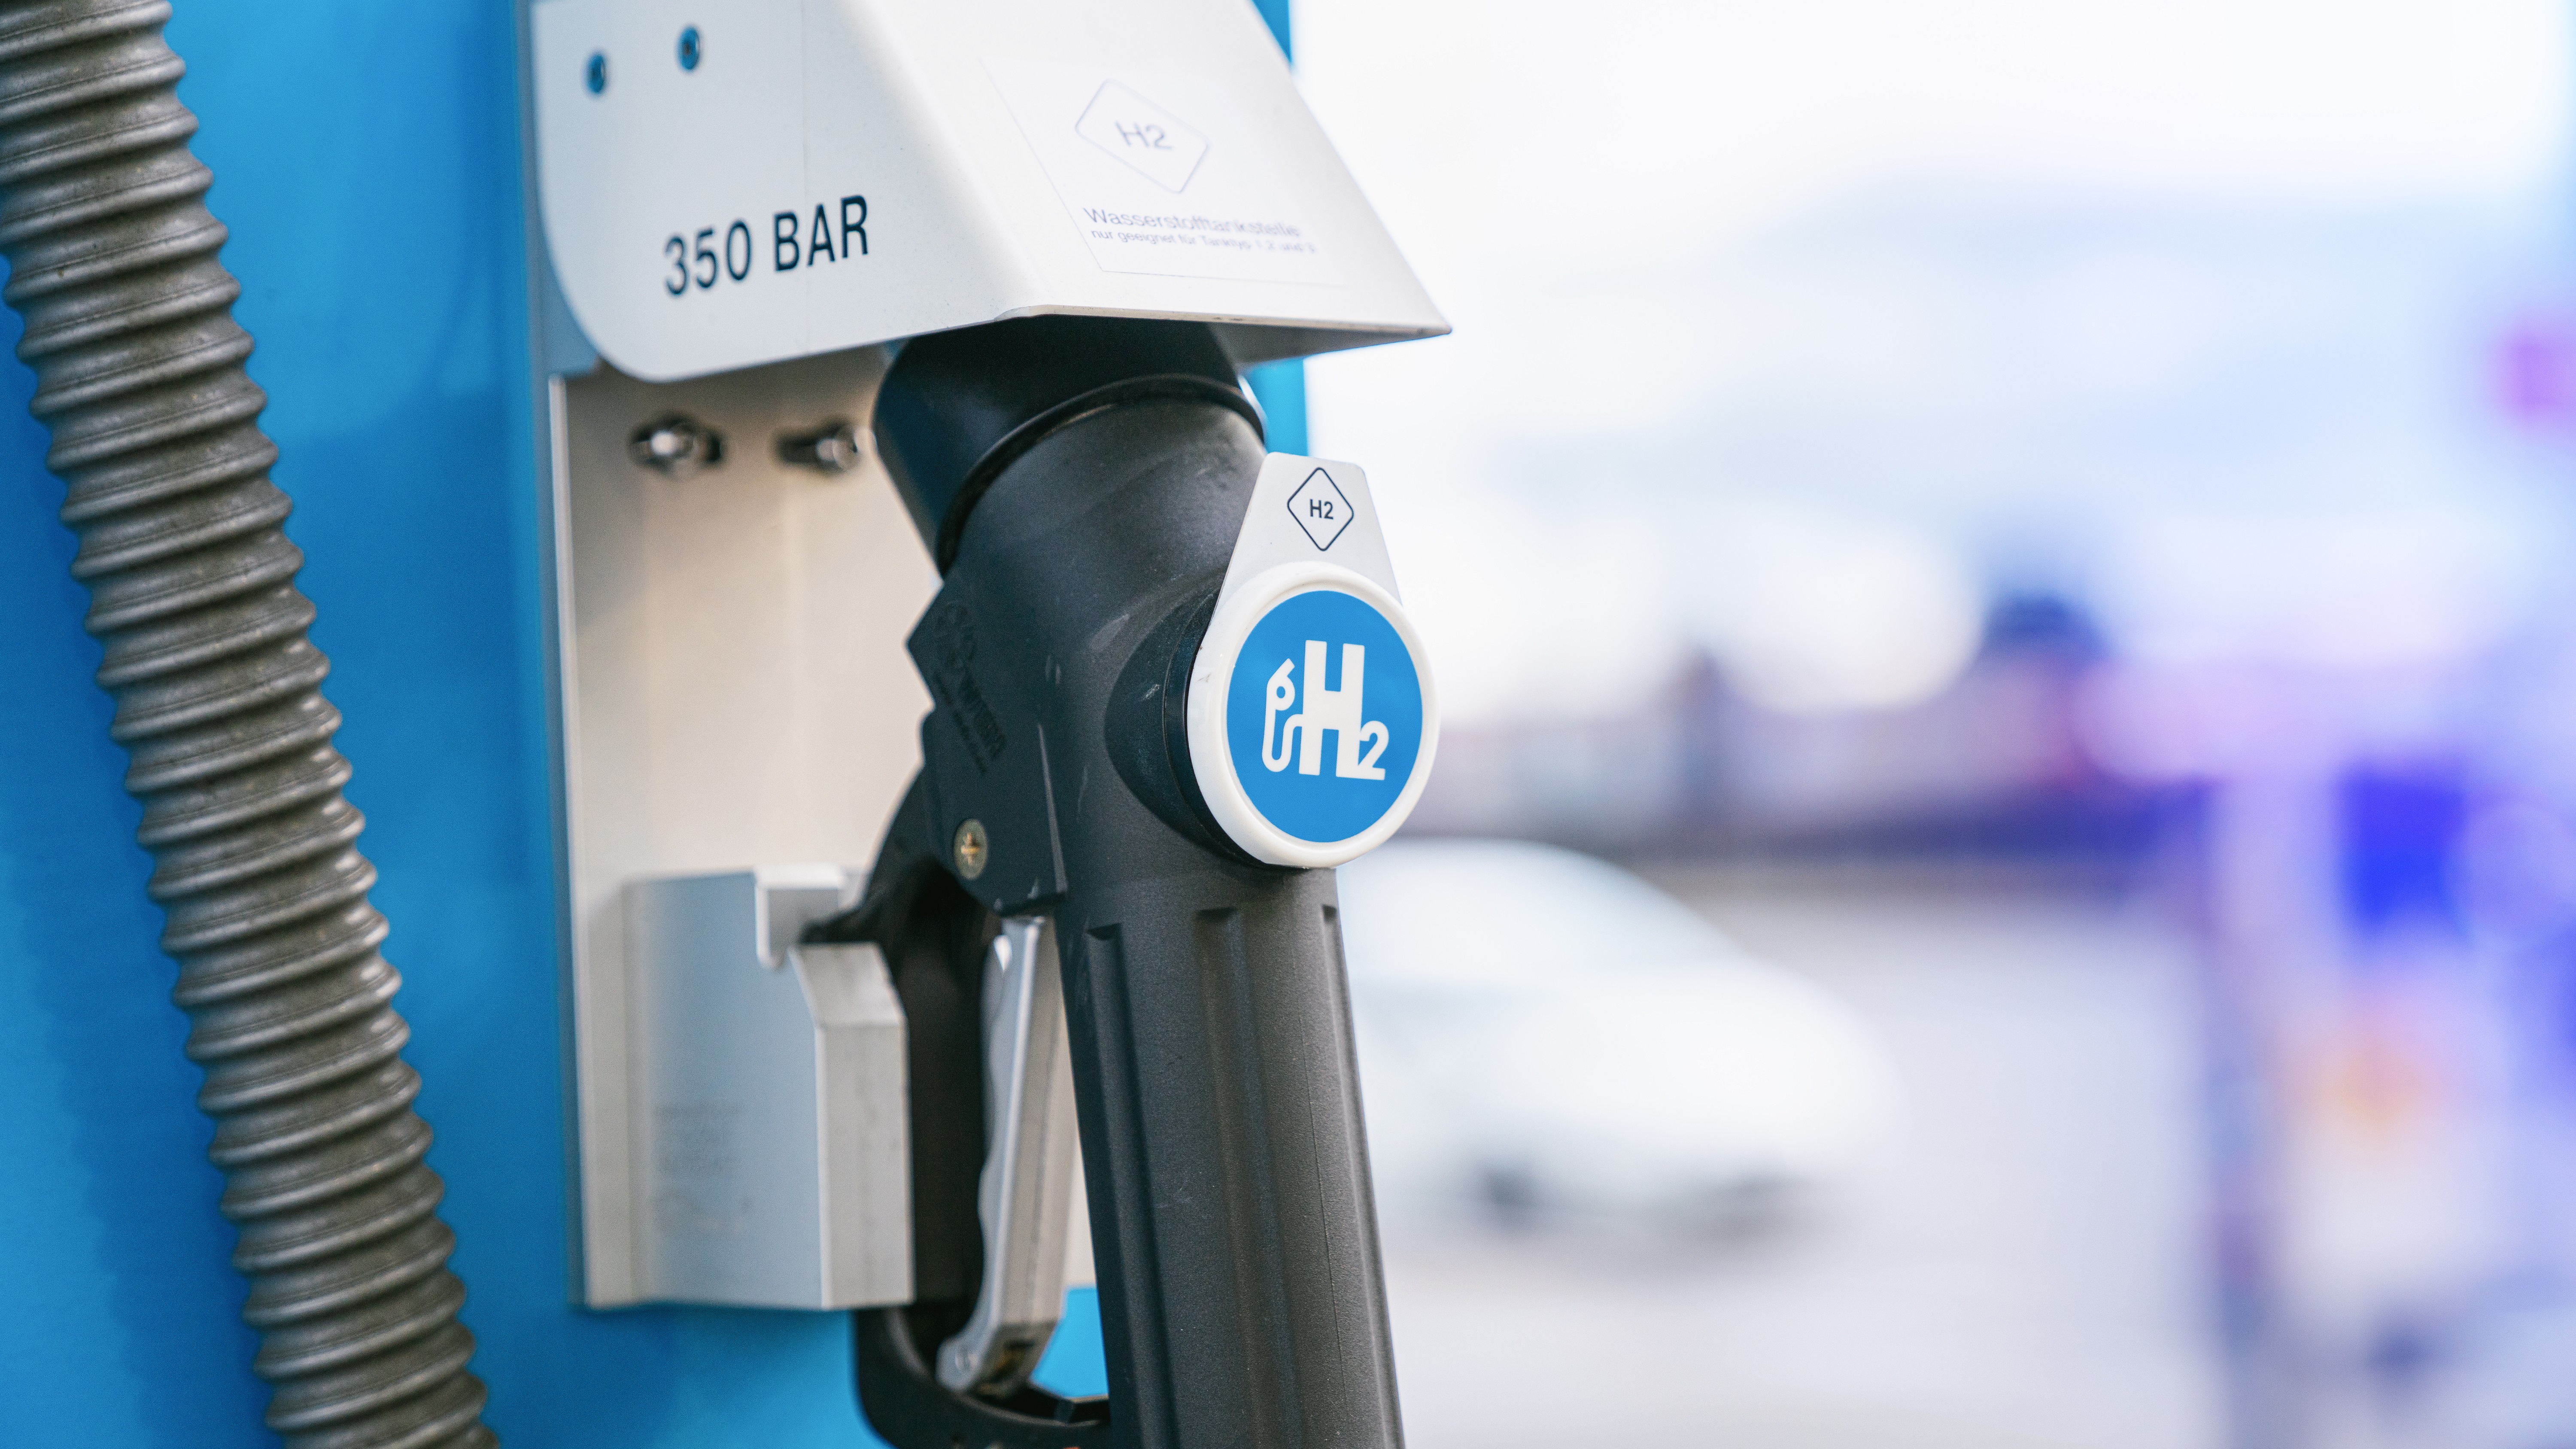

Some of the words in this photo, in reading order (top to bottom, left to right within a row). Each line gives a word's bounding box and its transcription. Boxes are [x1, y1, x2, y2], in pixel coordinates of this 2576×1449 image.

[1115, 121, 1173, 150] H2
[1082, 207, 1302, 239] Wasserstofftankstelle
[1091, 230, 1114, 240] nur
[1117, 231, 1176, 245] geeignet
[664, 219, 753, 297] 350
[773, 194, 869, 273] BAR
[1309, 498, 1335, 521] H2
[1298, 639, 1390, 781] H2
